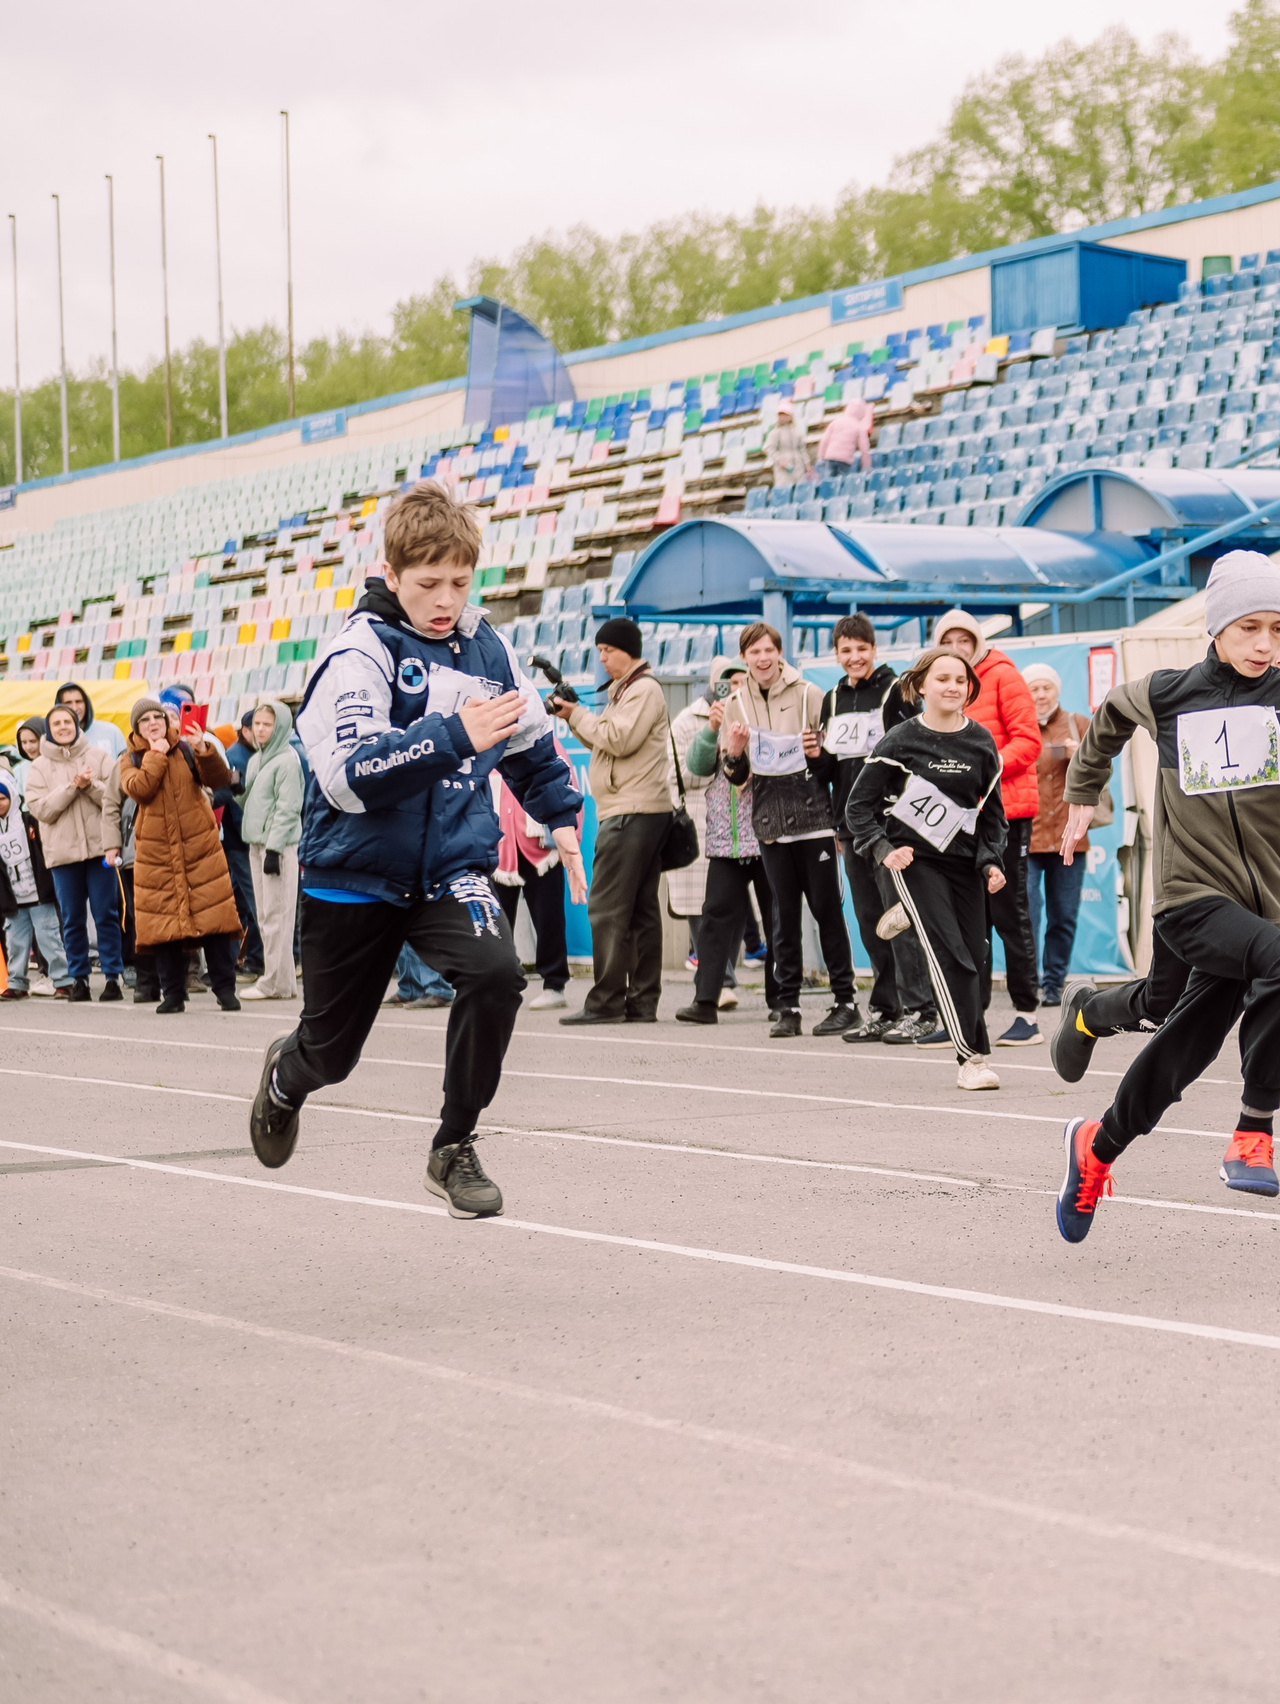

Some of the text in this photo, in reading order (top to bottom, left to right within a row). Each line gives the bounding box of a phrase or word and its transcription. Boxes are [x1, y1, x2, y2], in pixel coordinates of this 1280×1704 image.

[835, 722, 859, 745] 24
[1214, 719, 1240, 770] 1
[909, 794, 948, 828] 40
[0, 838, 23, 860] 35
